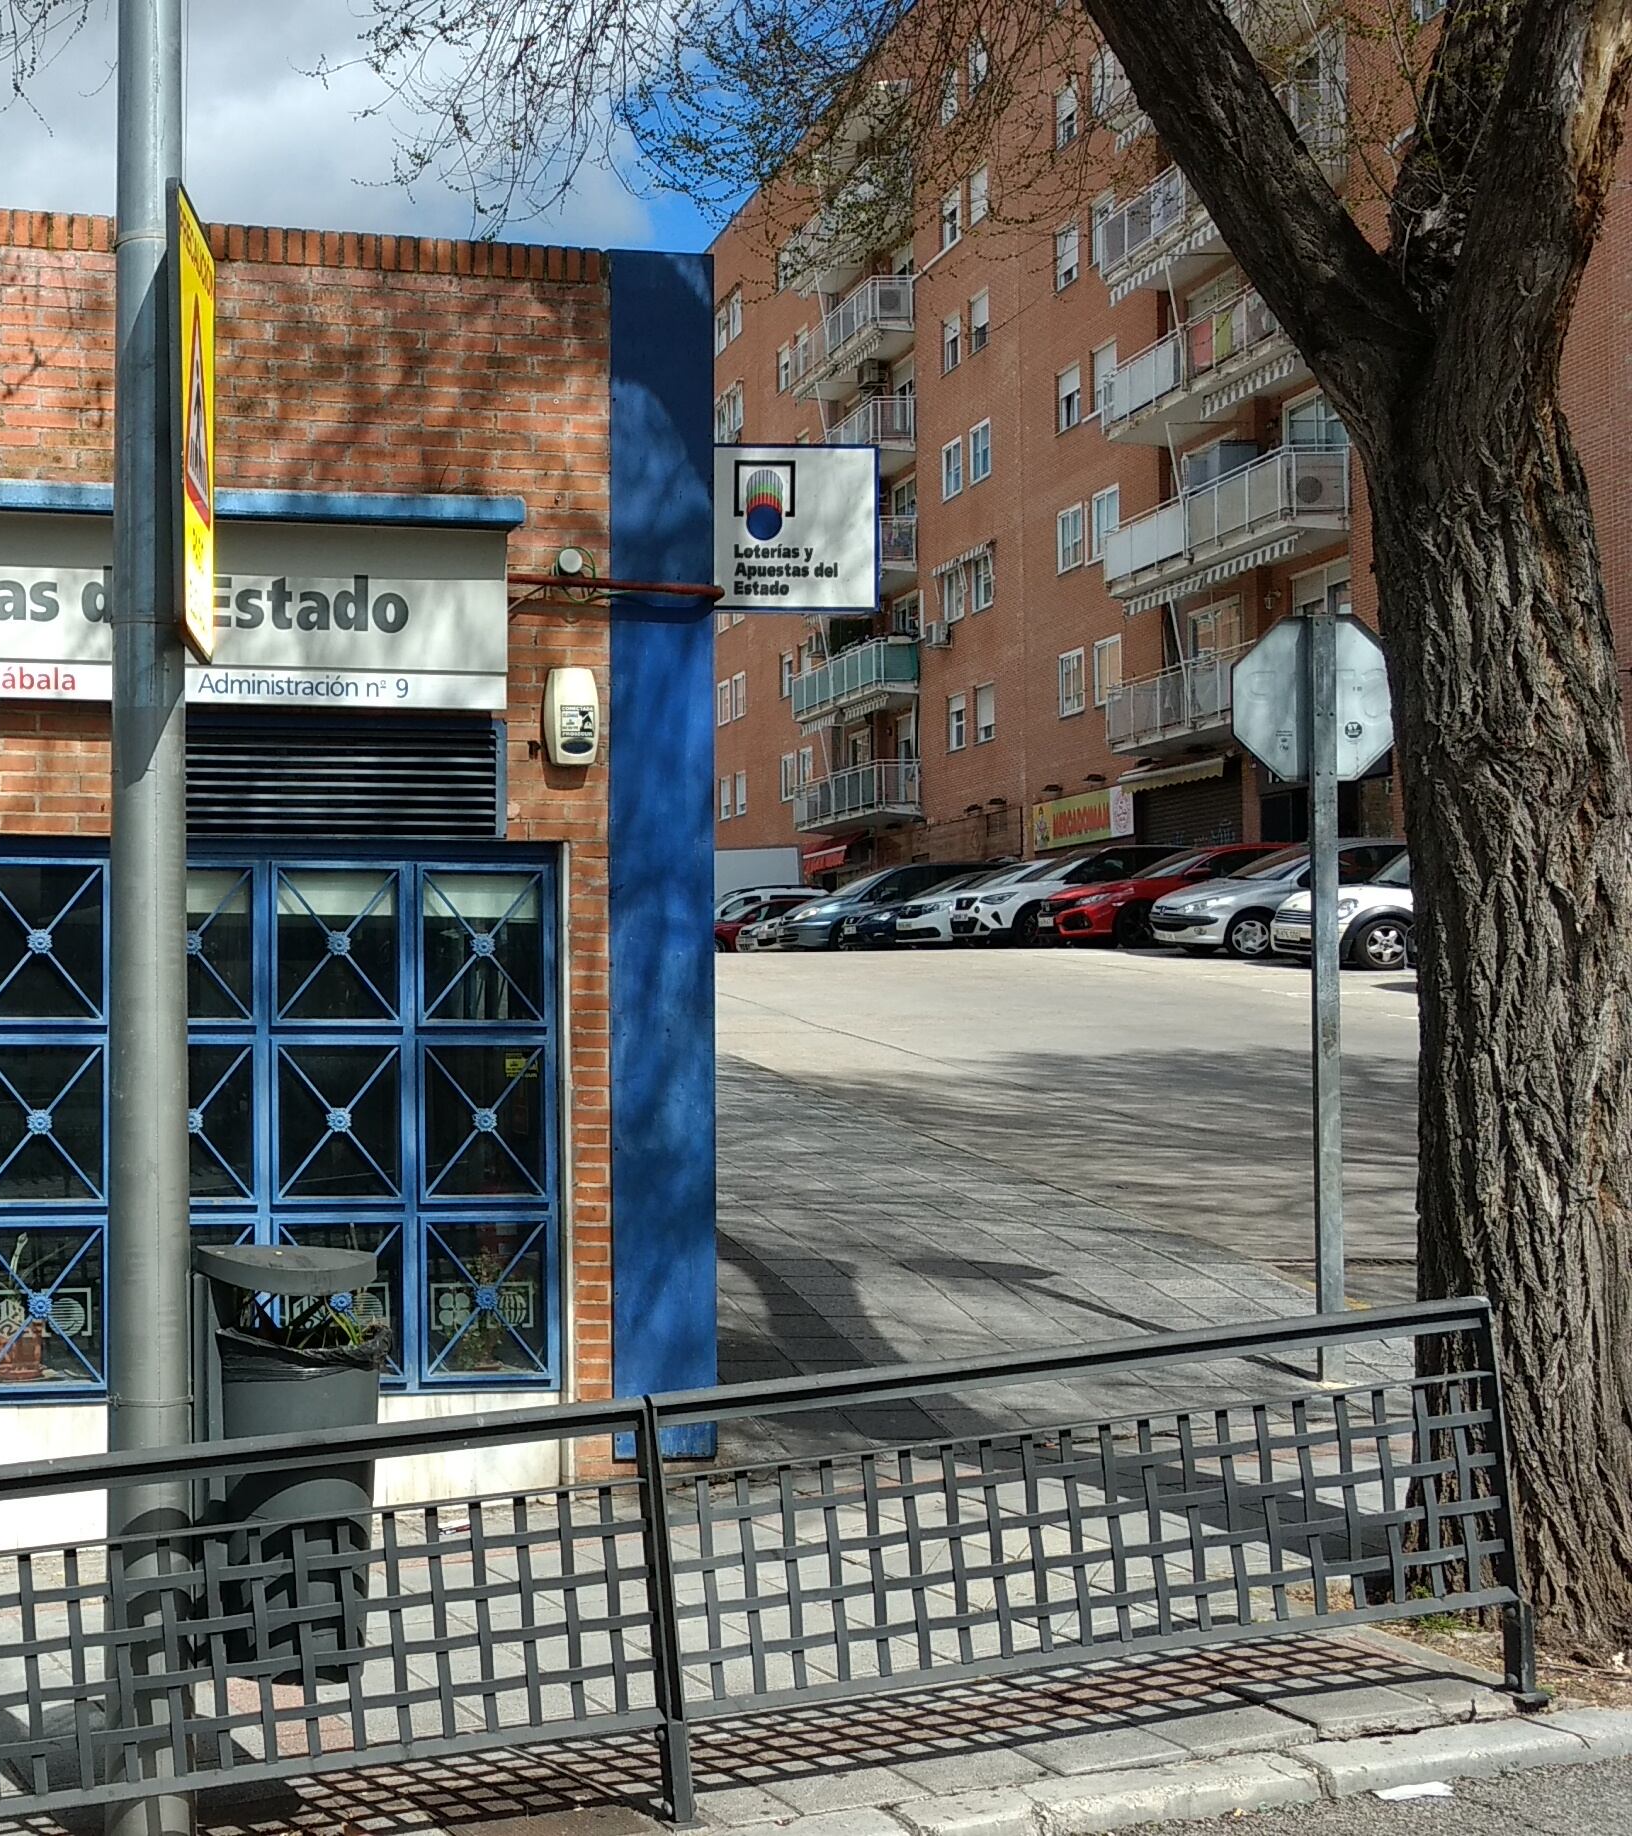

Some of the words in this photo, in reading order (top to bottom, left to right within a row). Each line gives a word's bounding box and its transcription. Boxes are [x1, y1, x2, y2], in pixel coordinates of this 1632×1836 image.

[734, 544, 800, 559] Loterías
[804, 547, 814, 562] y
[734, 562, 809, 580] Apuestas
[814, 562, 838, 578] del
[734, 581, 790, 596] Estado
[198, 673, 358, 698] Administración
[396, 679, 409, 698] 9
